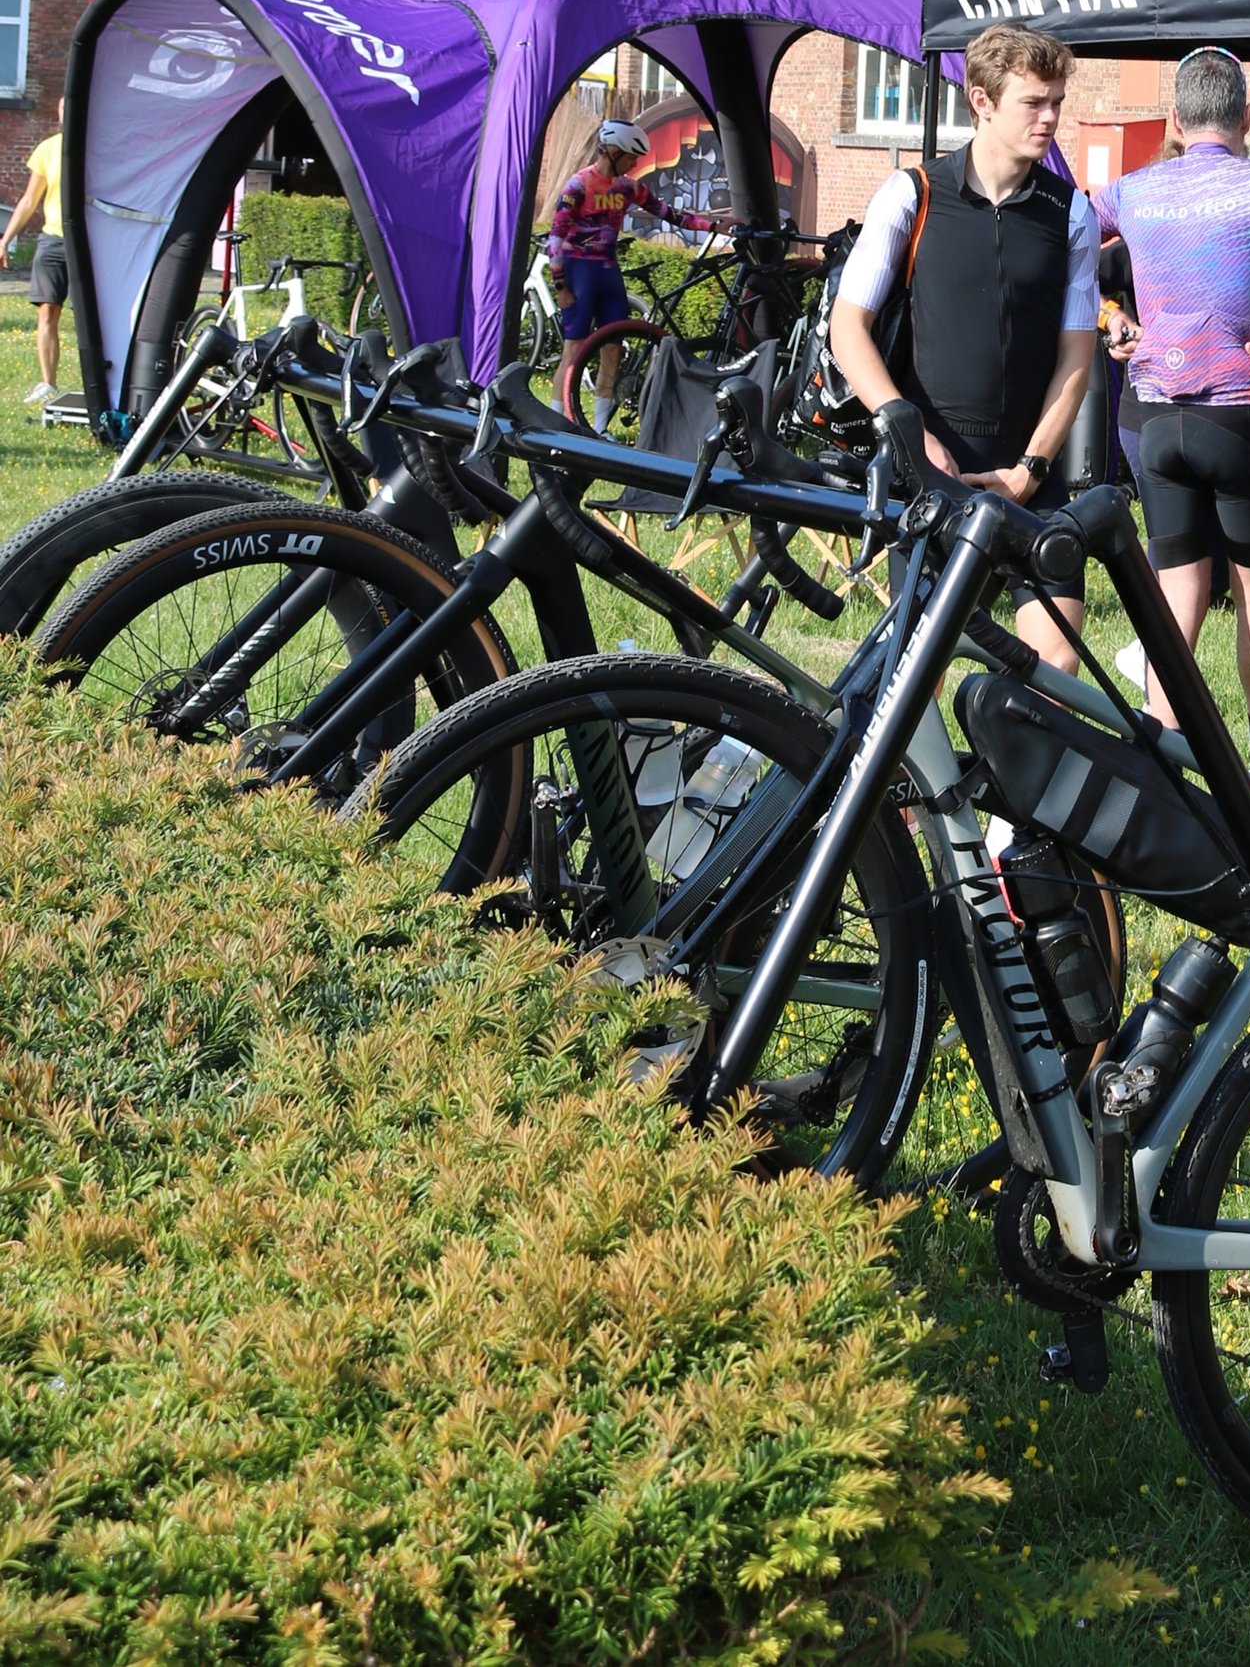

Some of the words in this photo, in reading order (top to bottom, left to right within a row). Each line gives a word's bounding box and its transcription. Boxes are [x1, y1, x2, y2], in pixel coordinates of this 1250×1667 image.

[594, 192, 625, 210] TNS
[1134, 206, 1187, 219] NOMAD
[1194, 198, 1236, 216] VELO
[193, 534, 272, 569] SWISS
[277, 533, 325, 556] DT
[952, 841, 1056, 1054] FACTOR
[918, 965, 927, 1008] Panaracer
